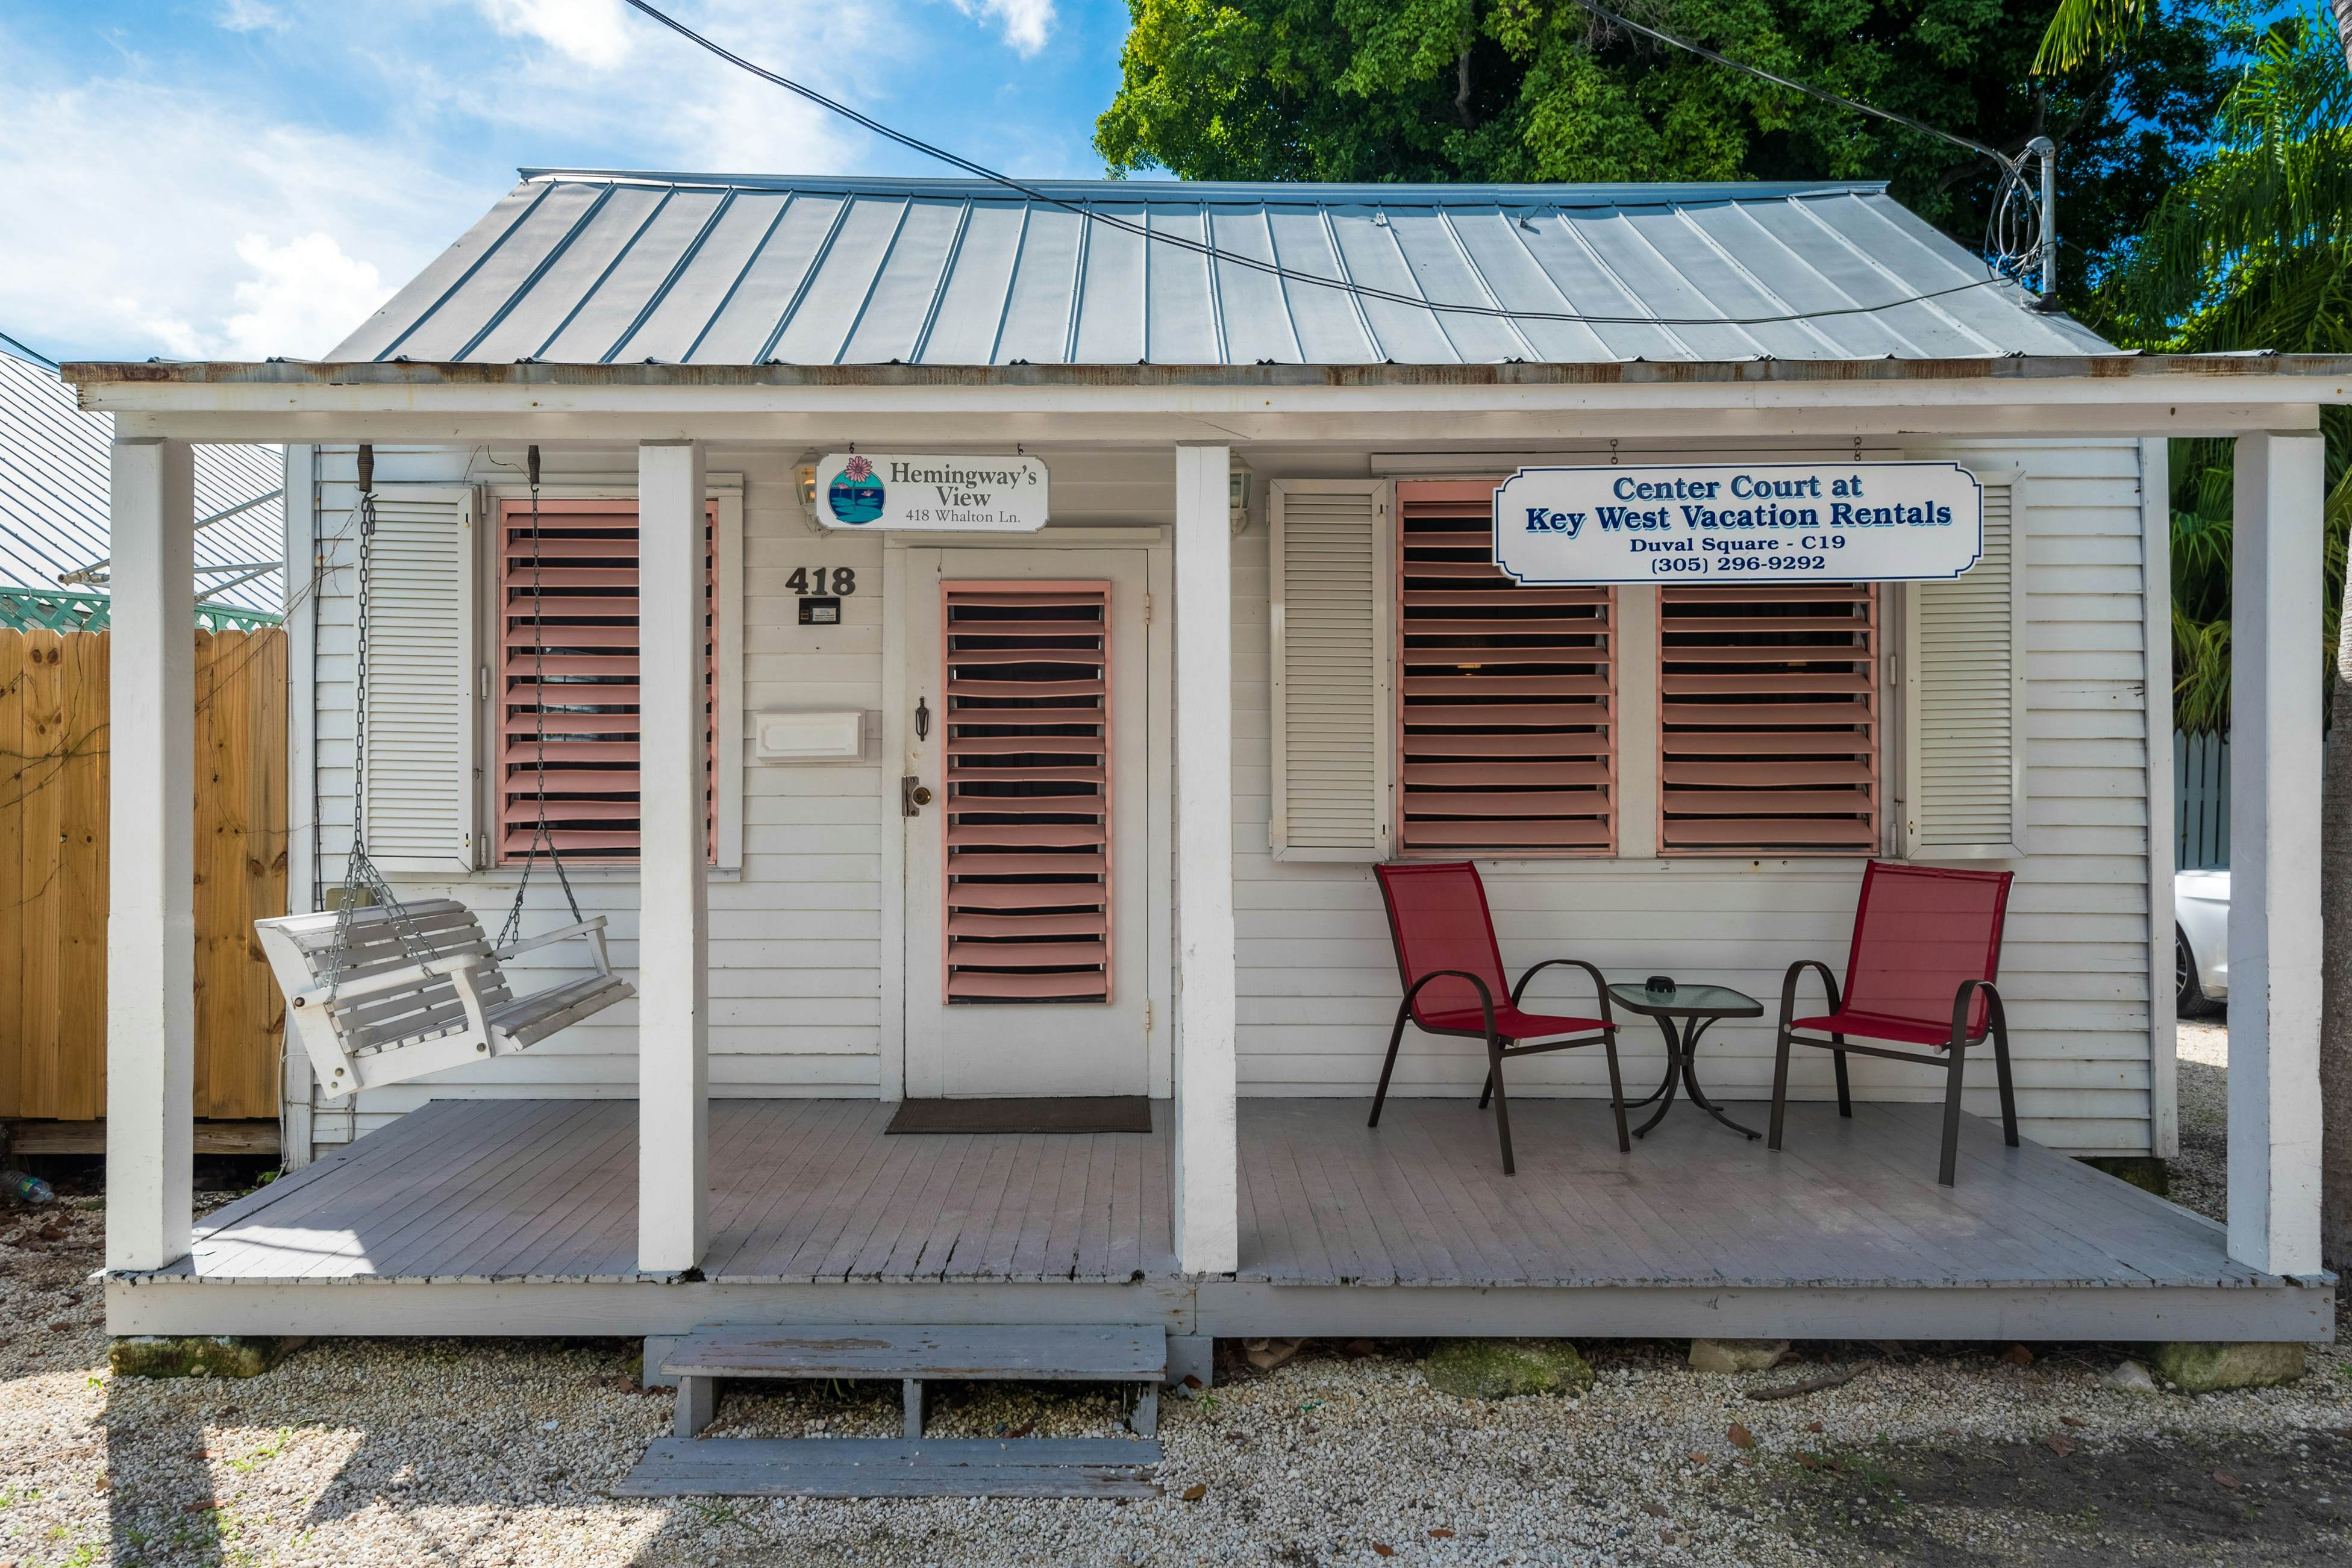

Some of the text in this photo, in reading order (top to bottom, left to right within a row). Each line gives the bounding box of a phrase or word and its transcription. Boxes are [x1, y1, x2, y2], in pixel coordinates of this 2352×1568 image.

[890, 462, 1037, 489] Hemingway's
[935, 486, 992, 507] View
[1613, 475, 1864, 501] Center Court at
[905, 509, 1021, 523] 418 Whalton Ln.
[1525, 500, 1953, 540] Key West Vacation Rentals
[1630, 537, 1694, 552] Duval
[1702, 537, 1779, 555] Square
[1801, 535, 1846, 549] C19
[1651, 555, 1826, 575] (305) 296-9292
[784, 567, 856, 596] 418
